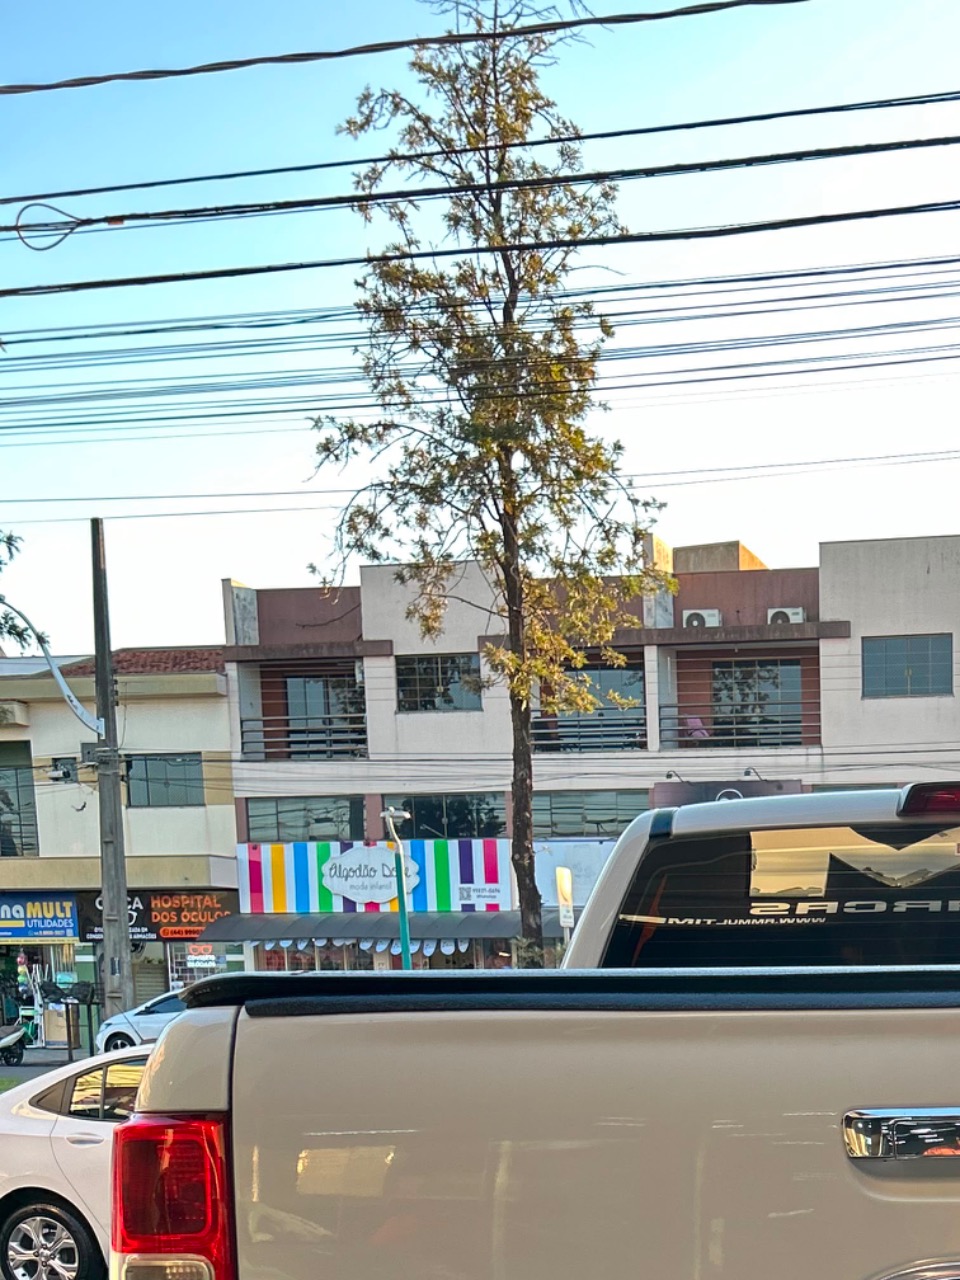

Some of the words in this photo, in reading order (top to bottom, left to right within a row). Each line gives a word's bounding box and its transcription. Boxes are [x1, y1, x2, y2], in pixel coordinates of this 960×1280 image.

[329, 862, 377, 881] Algodão
[381, 863, 411, 879] Doe
[349, 882, 368, 891] moda
[369, 881, 393, 891] infantil
[150, 895, 221, 909] HOSPITAL
[151, 911, 177, 923] DOS
[181, 908, 231, 923] ÓCULO
[27, 918, 74, 928] UTILIDADES
